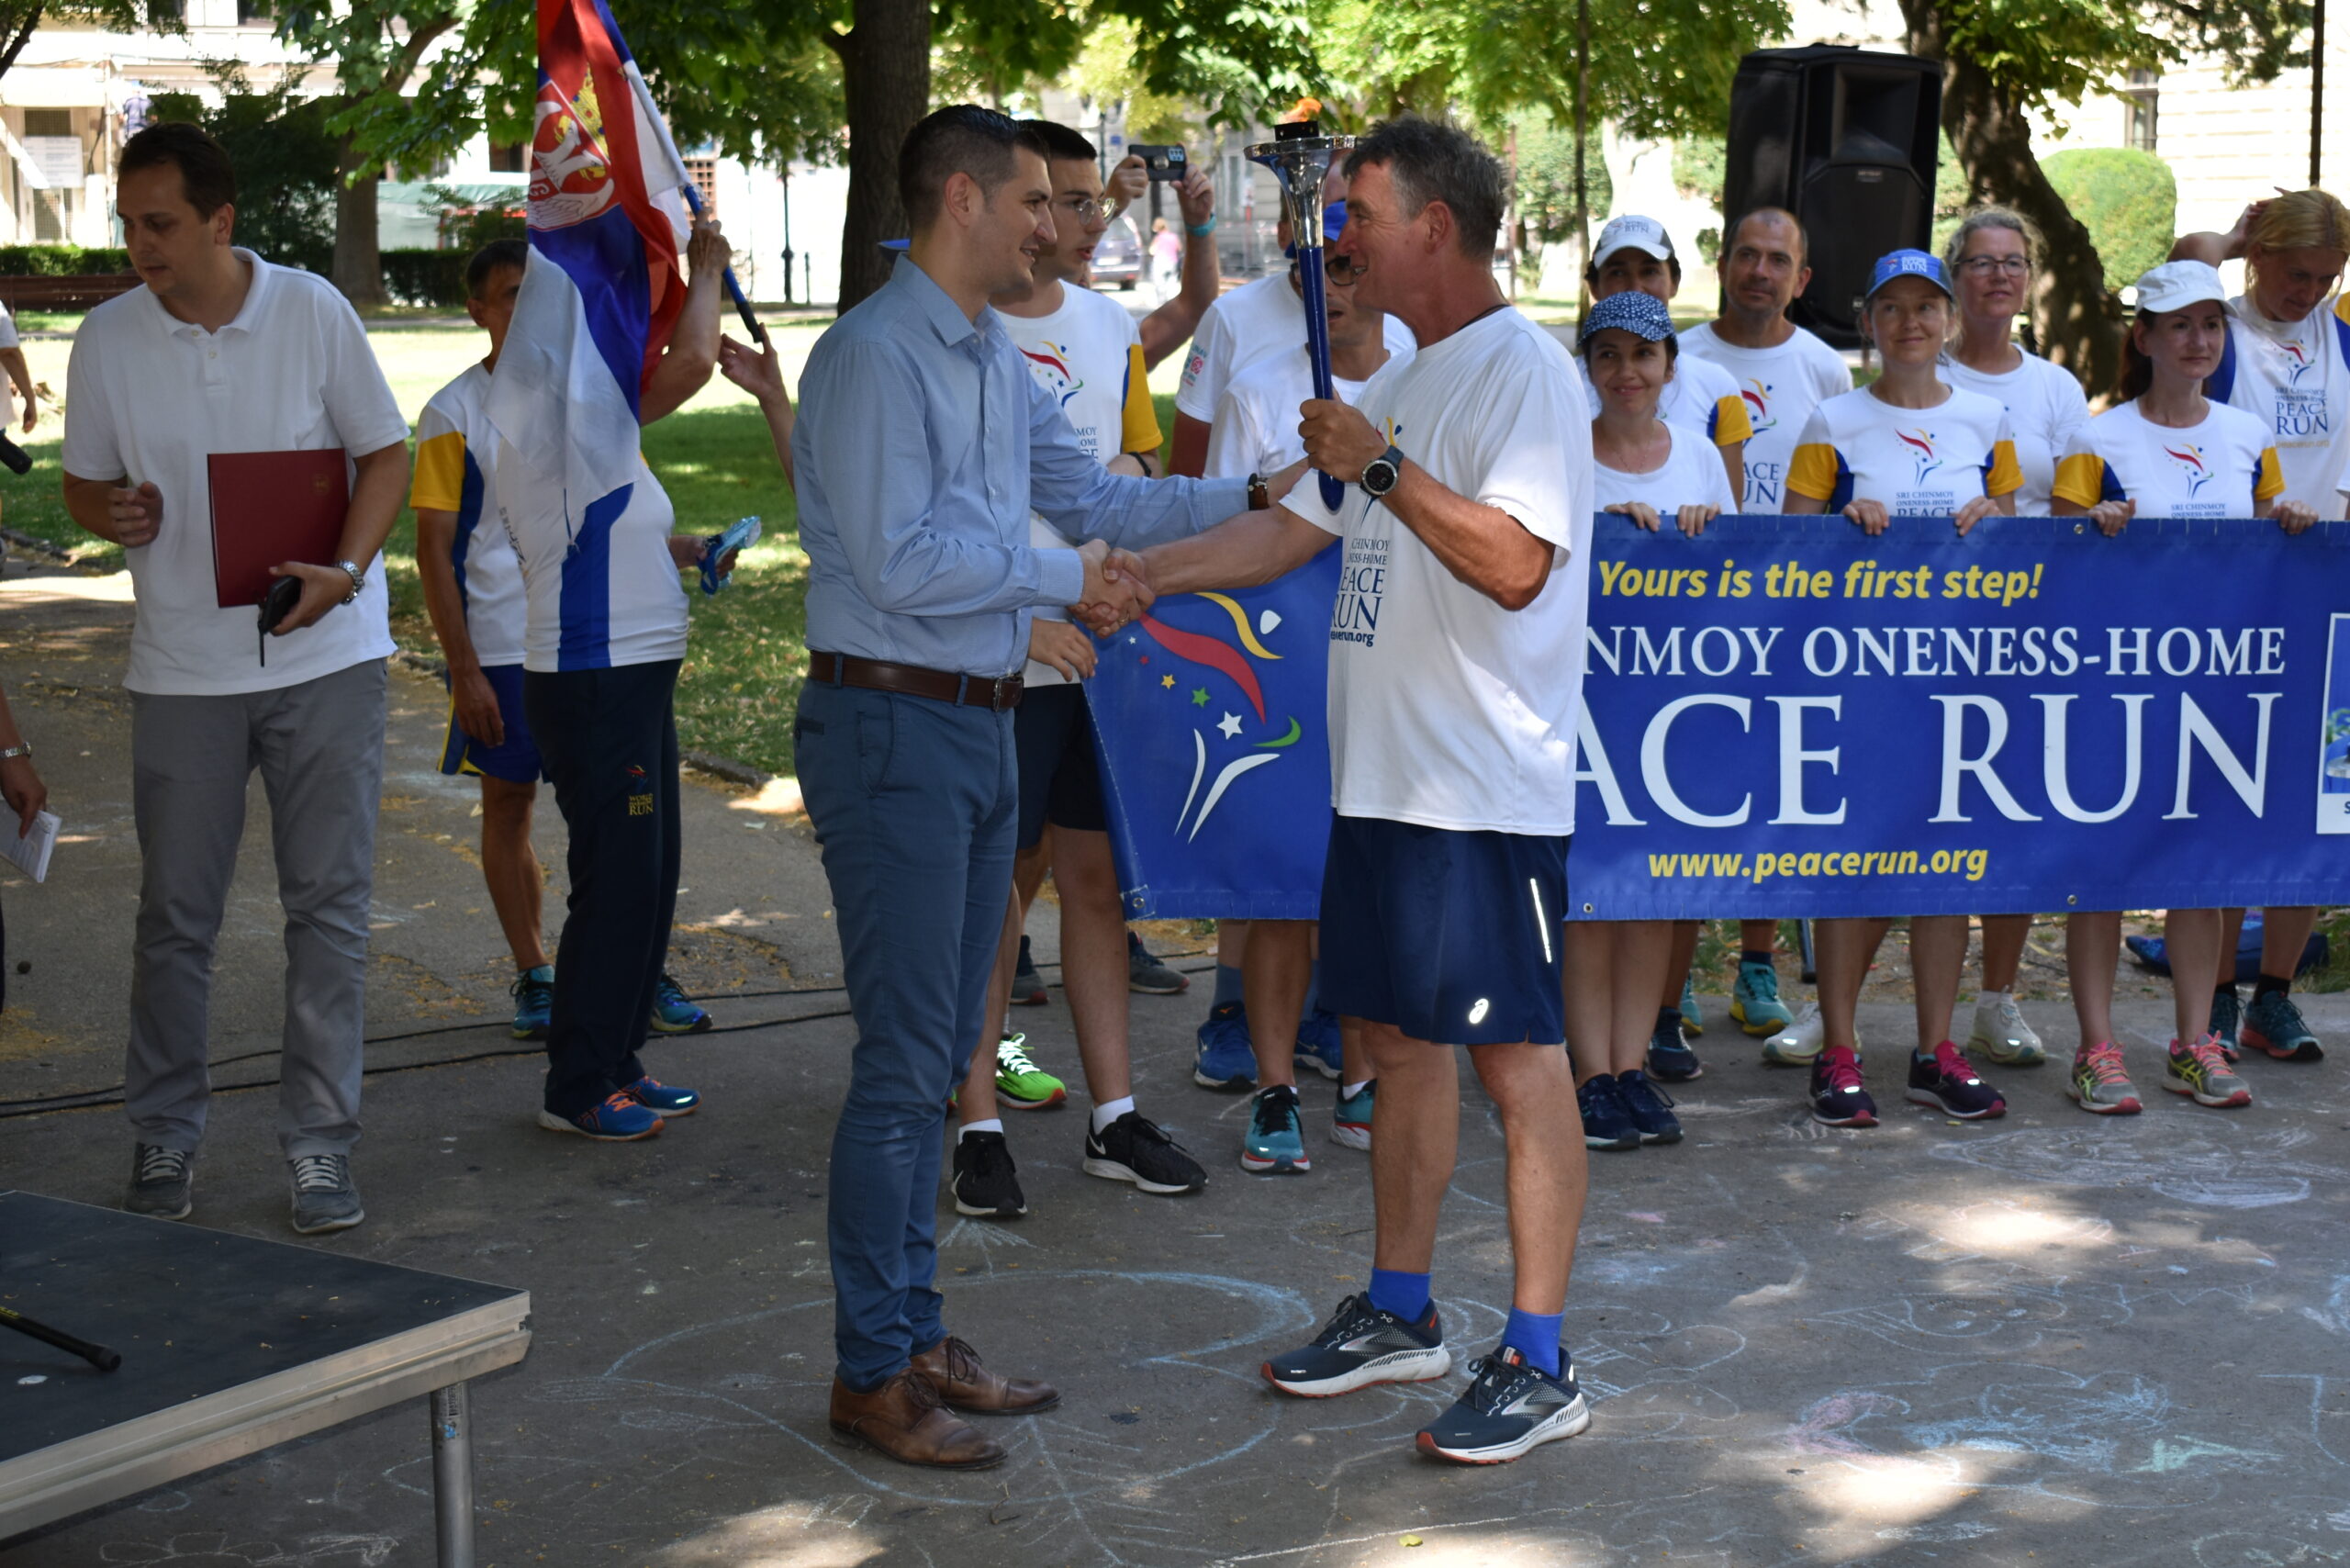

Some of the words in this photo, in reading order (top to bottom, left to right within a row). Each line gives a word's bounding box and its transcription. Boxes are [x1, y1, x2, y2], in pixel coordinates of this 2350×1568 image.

[1901, 263, 1927, 273] RUN
[2276, 413, 2329, 436] RUN
[1896, 491, 1910, 499] SRI
[1912, 490, 1954, 498] CHINMOY
[2171, 503, 2184, 511] SRI
[1598, 560, 1708, 598] Yours
[1718, 559, 1752, 598] is
[1765, 561, 1834, 598] the
[1843, 561, 1931, 599] first
[1942, 563, 2044, 607] step!
[1803, 626, 2286, 677] ONENESS-HOME
[1927, 691, 2284, 823] RUN
[629, 803, 654, 815] RUN
[1649, 849, 1988, 883] www.peacerun.org
